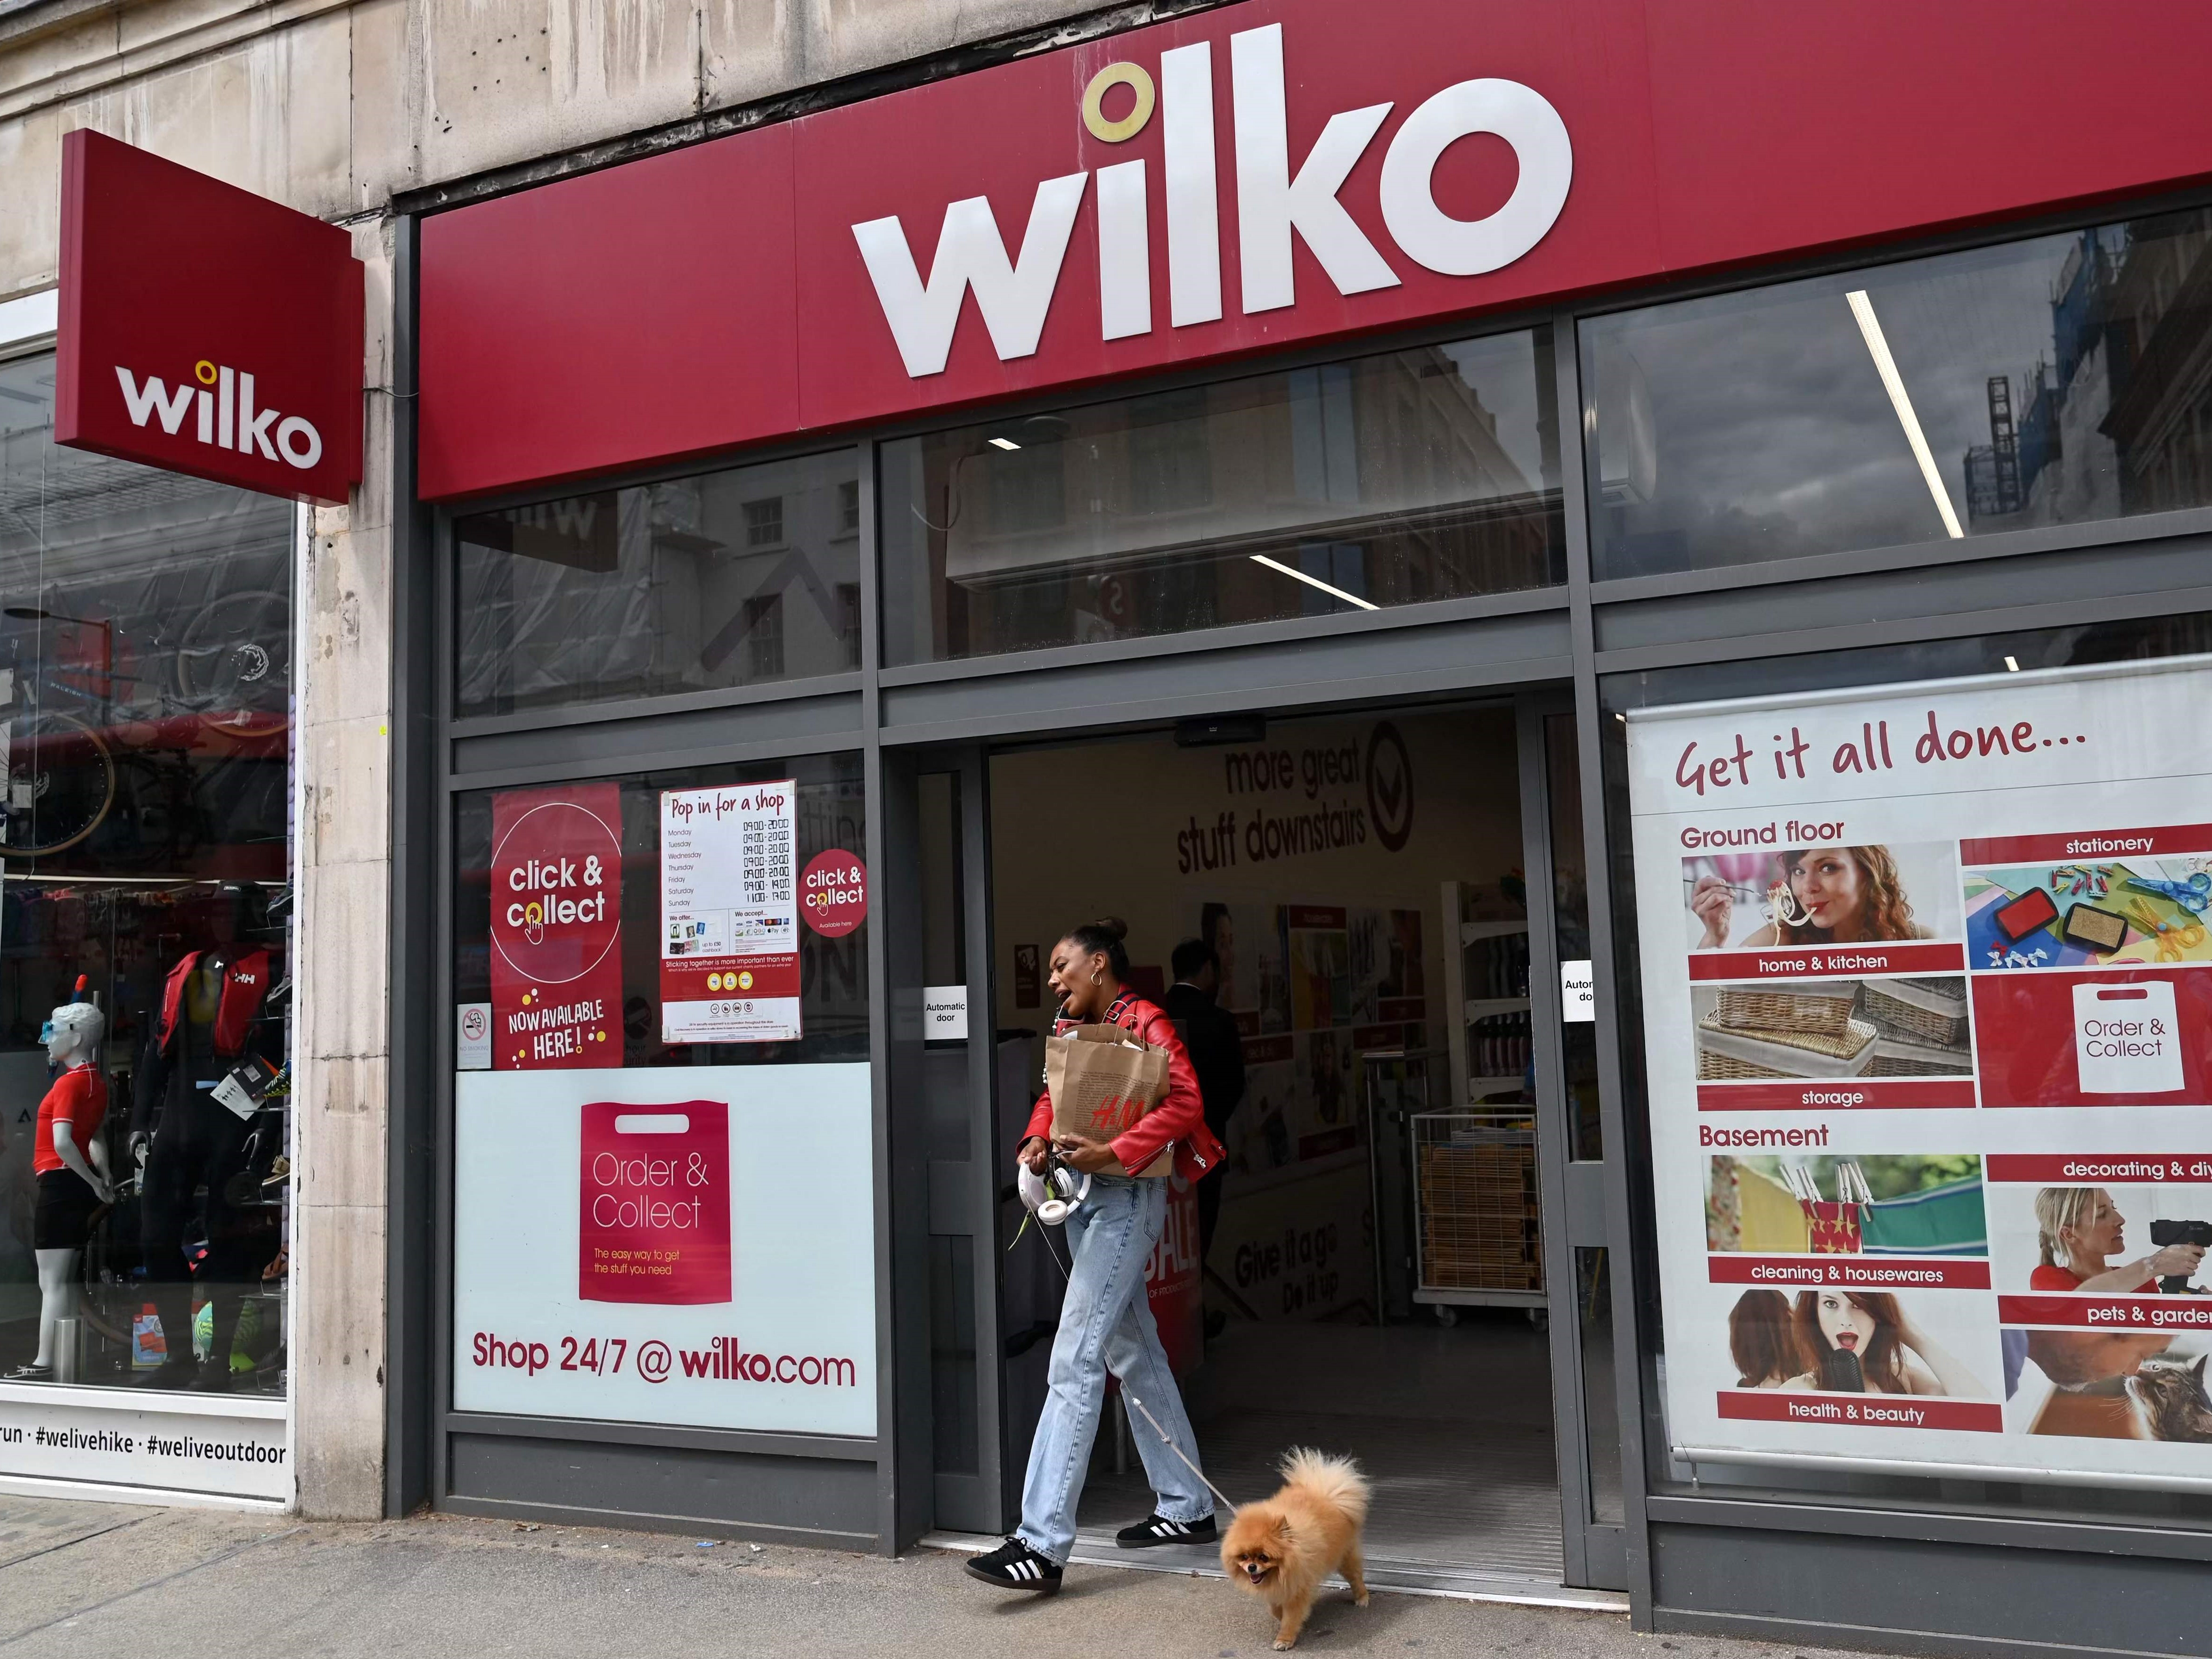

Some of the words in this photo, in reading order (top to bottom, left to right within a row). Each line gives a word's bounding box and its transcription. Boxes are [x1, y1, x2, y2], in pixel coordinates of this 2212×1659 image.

[851, 22, 1573, 379] wilko
[115, 360, 322, 469] wilko
[1676, 734, 1753, 795] Get
[1773, 727, 1810, 780] it
[1832, 720, 1893, 774] all
[1915, 710, 2086, 764] done...
[1226, 749, 1293, 794] more
[1302, 737, 1360, 799] great
[672, 799, 693, 824] Pop
[698, 796, 711, 814] in
[716, 793, 736, 821] for
[741, 798, 750, 810] a
[756, 789, 784, 816] shop
[1178, 810, 1236, 874] stuff
[1246, 800, 1366, 862] downstairs
[1681, 822, 1777, 849] Ground
[1786, 820, 1844, 842] floor
[2066, 837, 2153, 854] stationery
[509, 858, 577, 891] click
[583, 855, 603, 886] &
[807, 868, 846, 888] click
[849, 866, 861, 883] &
[806, 886, 863, 907] collect
[506, 891, 605, 927] collect
[689, 960, 714, 968] together
[737, 956, 765, 965] important
[1759, 958, 1805, 973] home
[1811, 957, 1823, 970] &
[1828, 955, 1887, 969] kitchen
[926, 1002, 965, 1012] Automatic
[1579, 992, 1592, 1001] do
[508, 1011, 540, 1034] NOW
[541, 999, 604, 1029] AVAILABLE
[936, 1013, 955, 1022] door
[2084, 1020, 2143, 1037] Order
[2150, 1018, 2165, 1035] &
[2086, 1039, 2162, 1057] Collect
[1802, 1090, 1864, 1107] storage
[1089, 1095, 1145, 1130] H&M
[1699, 1124, 1828, 1146] Basement
[593, 1152, 677, 1186] Order
[686, 1152, 709, 1186] &
[2063, 1162, 2164, 1180] decorating
[2171, 1161, 2184, 1176] &
[593, 1193, 702, 1228] Collect
[594, 1248, 609, 1259] The
[611, 1250, 632, 1261] easy
[634, 1250, 652, 1261] way
[653, 1250, 662, 1260] to
[664, 1250, 680, 1262] get
[1235, 1242, 1280, 1287] Give
[1285, 1229, 1295, 1269] it
[1300, 1231, 1312, 1263] a
[594, 1263, 608, 1273] the
[611, 1263, 627, 1274] stuff
[629, 1266, 645, 1276] you
[648, 1264, 672, 1275] need
[1751, 1265, 1823, 1283] cleaning
[1828, 1266, 1840, 1280] &
[1845, 1266, 1943, 1282] housewares
[1149, 1289, 1158, 1299] OF
[1283, 1281, 1303, 1314] Do
[1307, 1273, 1315, 1303] it
[1321, 1272, 1339, 1301] up
[2088, 1306, 2126, 1323] pets
[2132, 1307, 2146, 1321] &
[473, 1332, 548, 1376] Shop
[560, 1336, 627, 1376] 24/7
[637, 1340, 672, 1383] @
[678, 1336, 855, 1387] wilko.com
[1789, 1402, 1840, 1418] health
[1846, 1405, 1859, 1419] &
[1864, 1406, 1925, 1425] beauty
[35, 1427, 133, 1453] #welivehike
[147, 1435, 286, 1463] #weliveoutdoor
